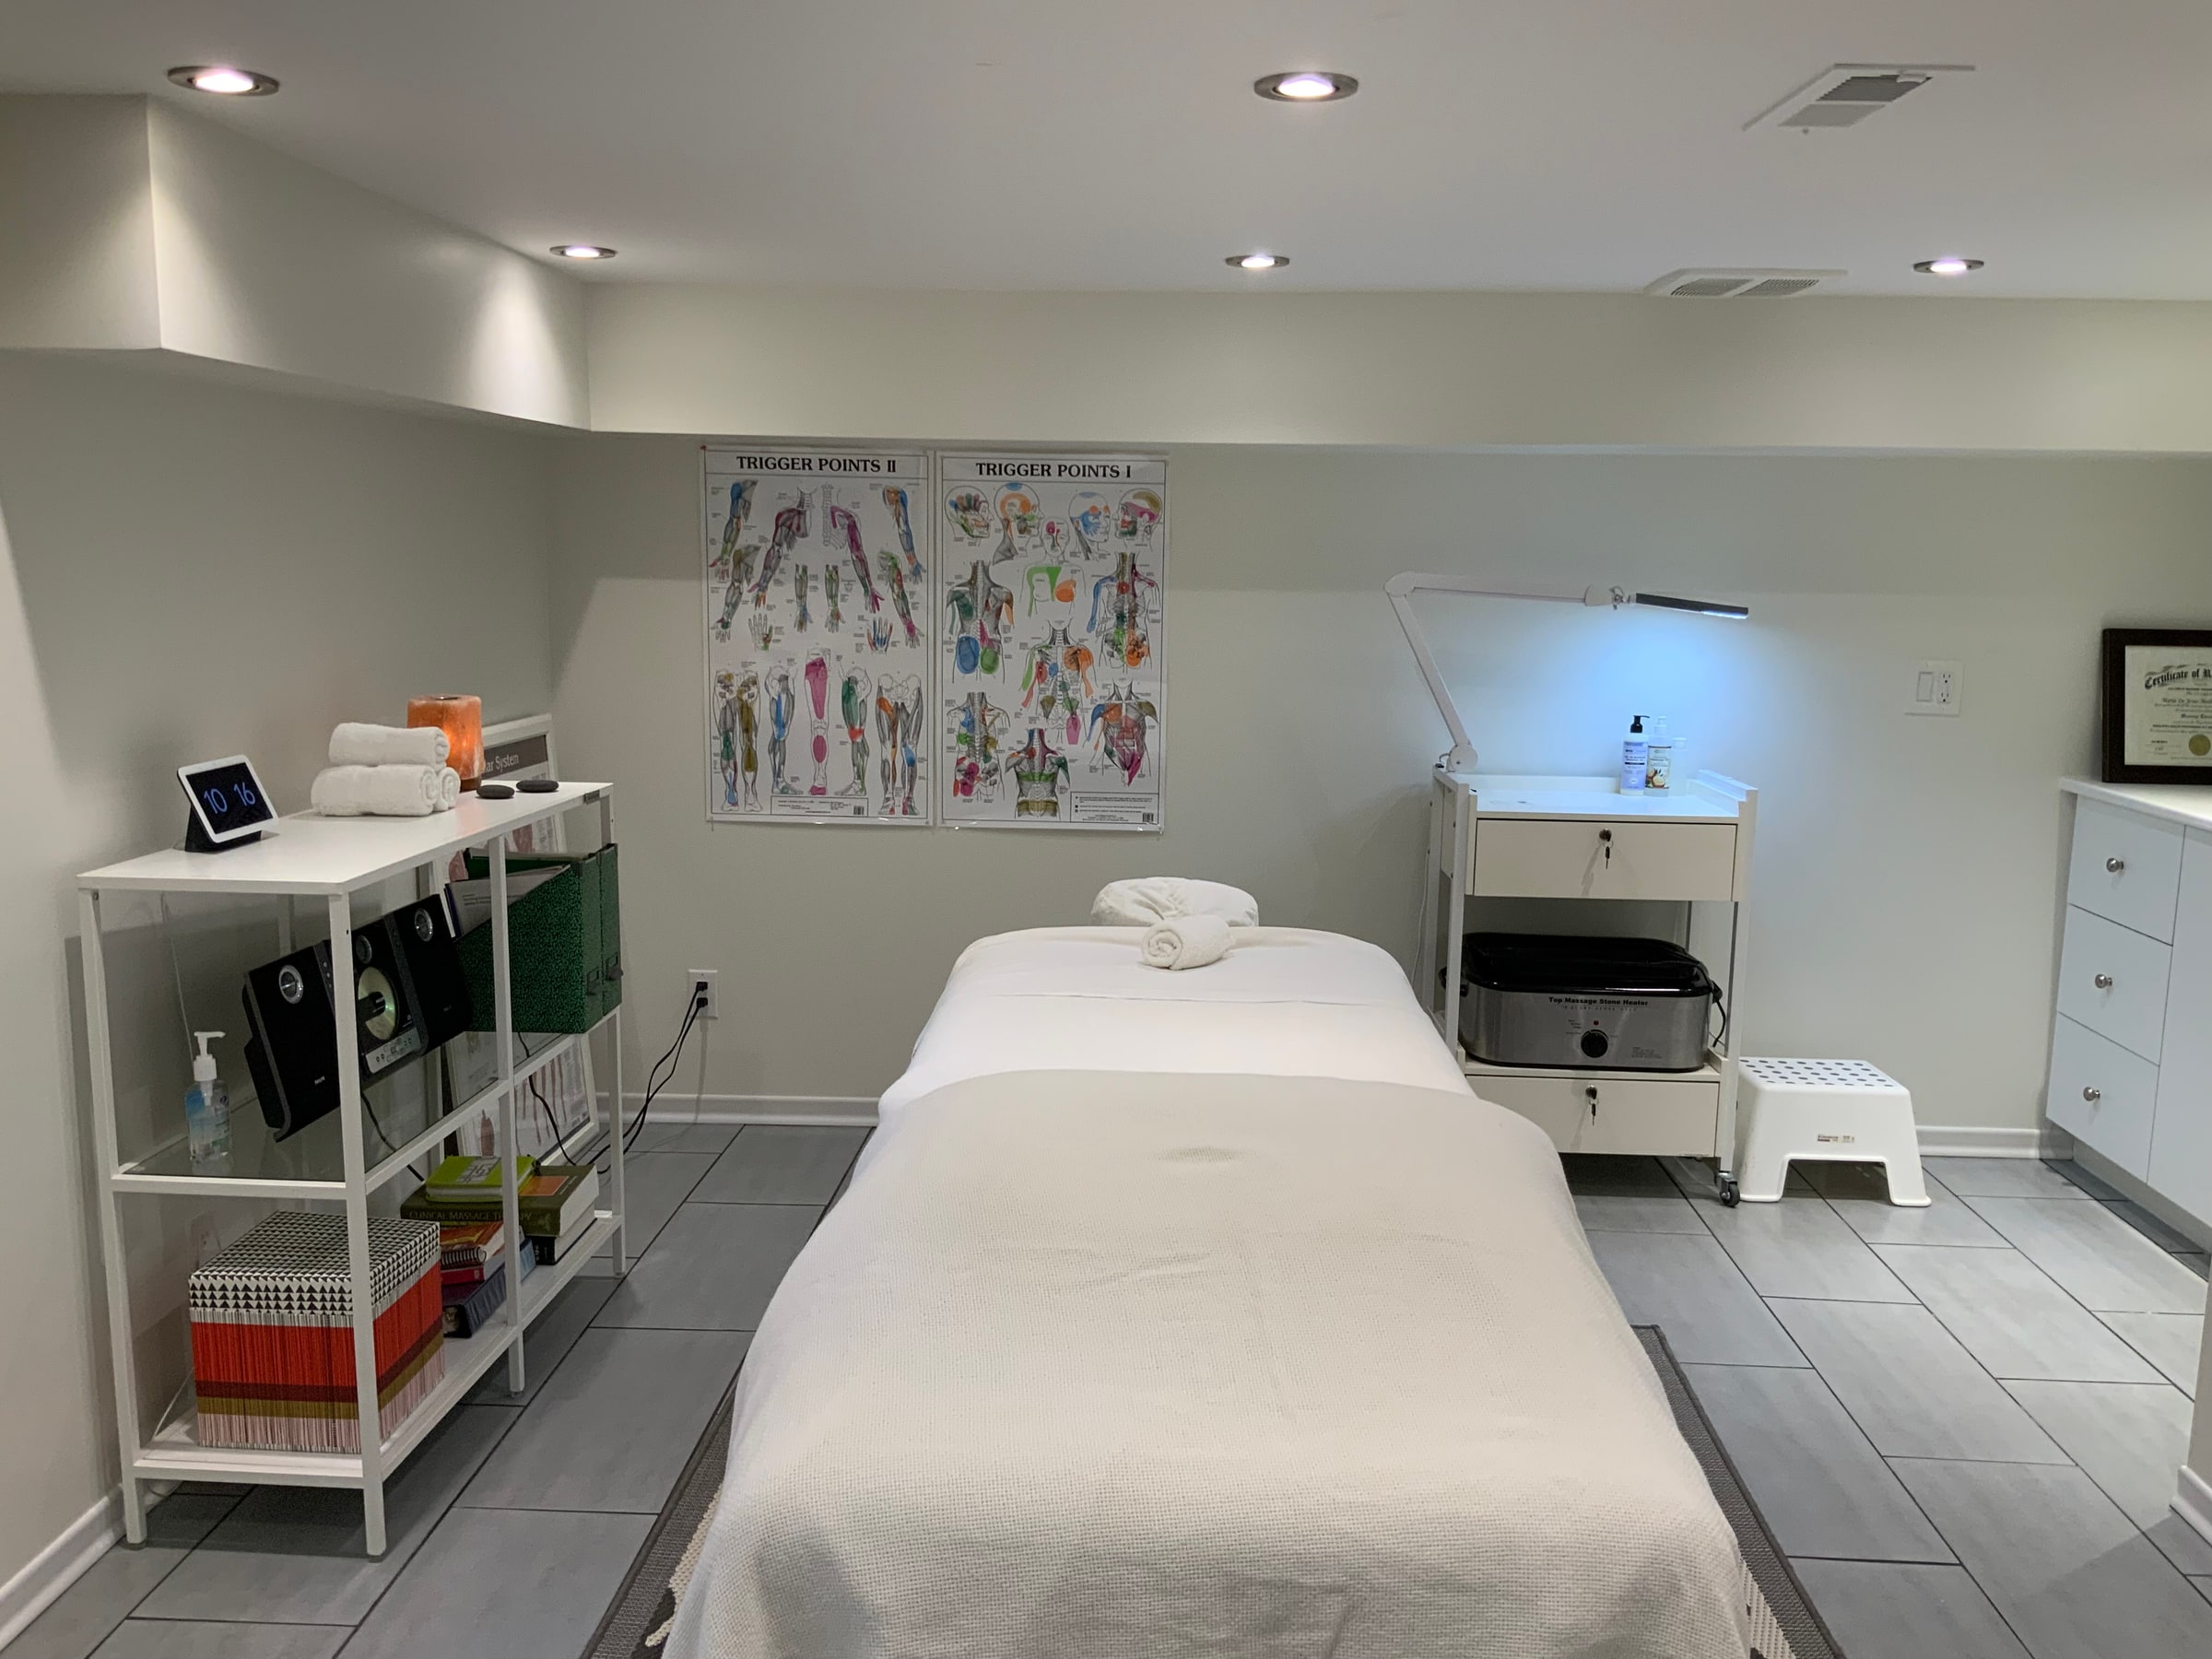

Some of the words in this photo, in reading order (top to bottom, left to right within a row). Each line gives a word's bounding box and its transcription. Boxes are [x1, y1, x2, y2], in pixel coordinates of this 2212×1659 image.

[736, 456, 813, 471] TRIGGER
[818, 458, 881, 473] POINTS
[888, 460, 897, 473] II
[976, 463, 1052, 477] TRIGGER
[1057, 465, 1120, 478] POINTS
[1126, 465, 1131, 478] I
[2145, 670, 2189, 690] Certificate
[495, 754, 519, 773] System
[204, 788, 228, 814] 10
[233, 782, 256, 806] 16
[1564, 997, 1597, 1006] Massage
[409, 1211, 447, 1219] CLINICAL
[449, 1212, 488, 1220] MASSAGE
